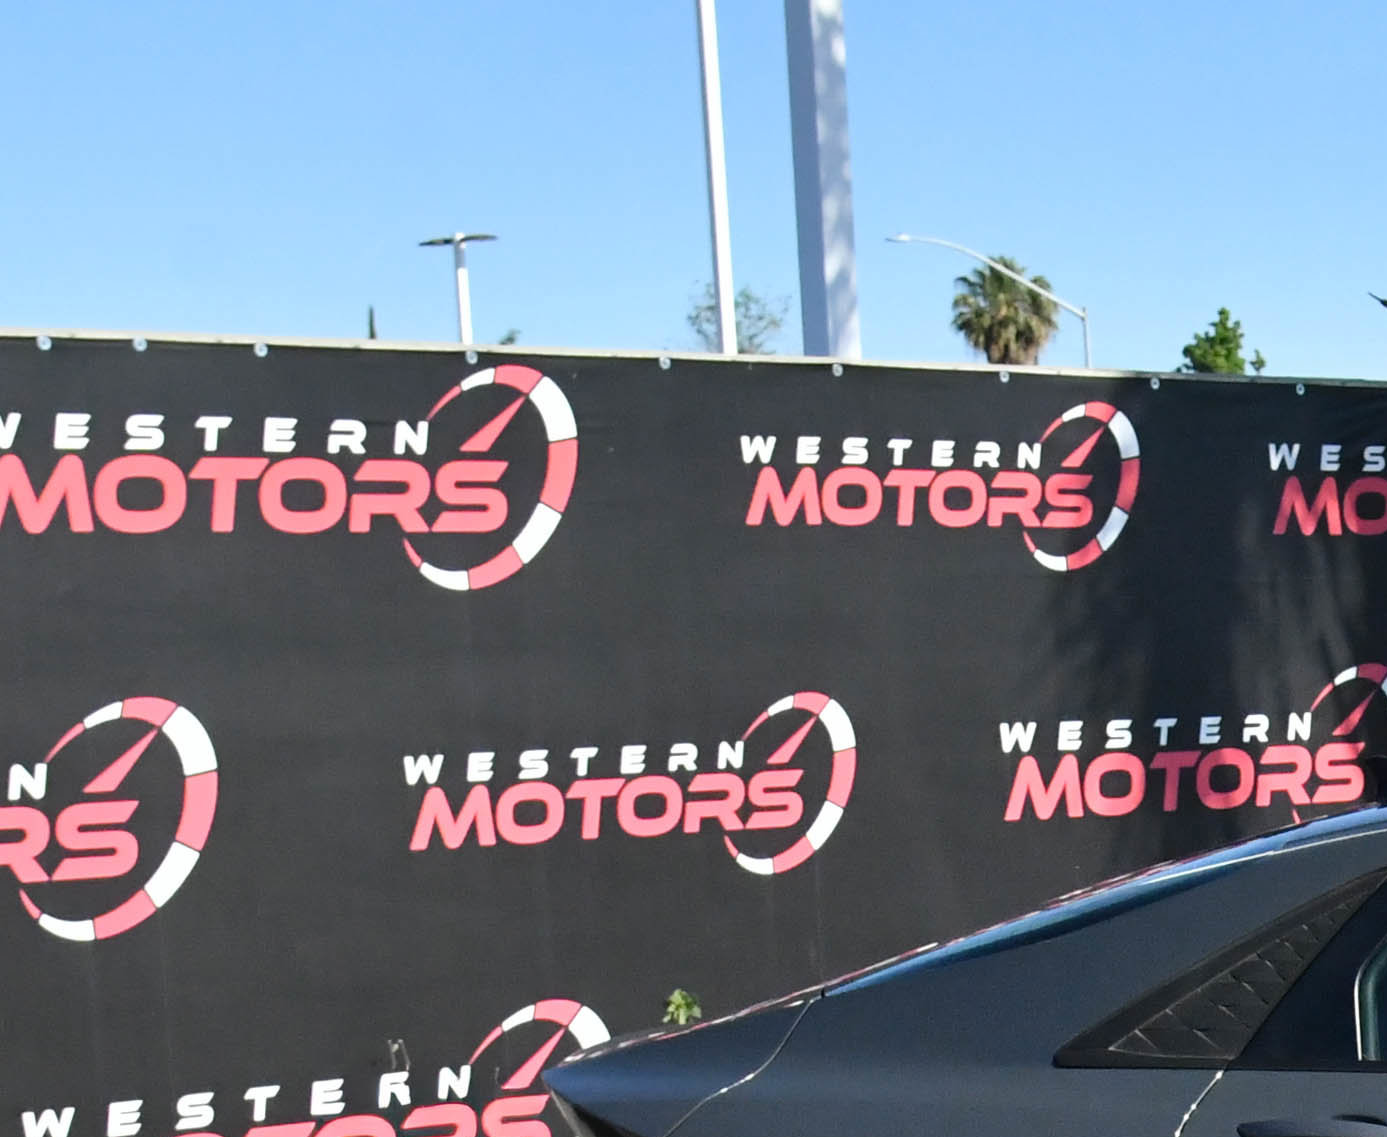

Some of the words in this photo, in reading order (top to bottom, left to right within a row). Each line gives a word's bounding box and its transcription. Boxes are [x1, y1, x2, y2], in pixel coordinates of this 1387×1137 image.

[739, 434, 1042, 470] WESTERN
[0, 453, 510, 535] MOTORS
[744, 465, 1094, 529] MOTORS
[402, 740, 745, 786] WESTERN
[999, 711, 1312, 754] WESTERN
[408, 767, 805, 852] MOTORS
[1003, 740, 1366, 823] MOTORS
